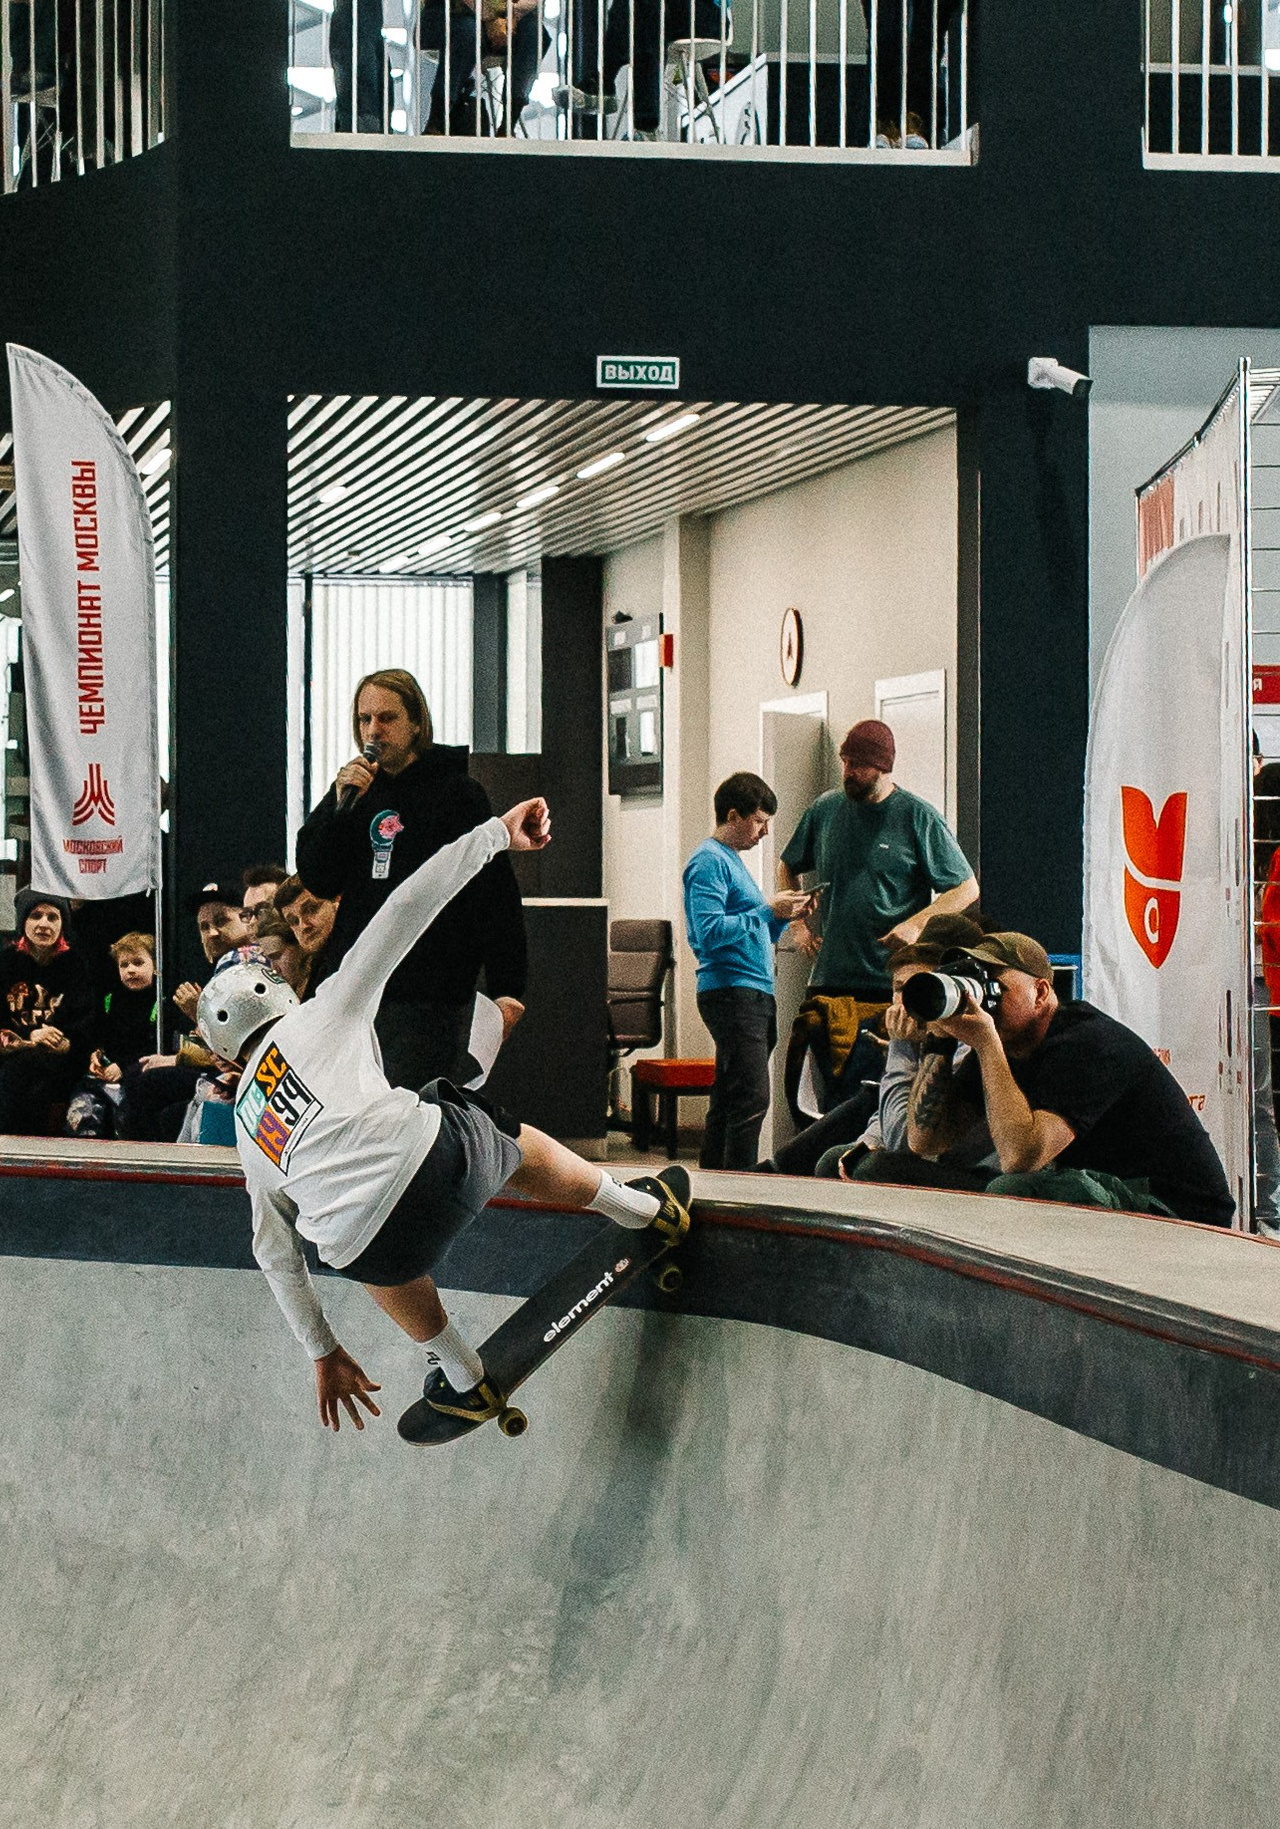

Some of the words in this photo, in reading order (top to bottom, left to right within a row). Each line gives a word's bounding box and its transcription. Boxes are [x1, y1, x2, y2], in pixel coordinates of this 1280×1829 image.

[604, 364, 674, 383] ВЫХОД
[71, 459, 101, 571] МОСКВЫ
[77, 579, 106, 735] ЧЕМПИОНАТ
[62, 835, 124, 855] МОСКОВСКИЙ
[78, 858, 107, 874] СПОРТ
[543, 1271, 615, 1342] element
